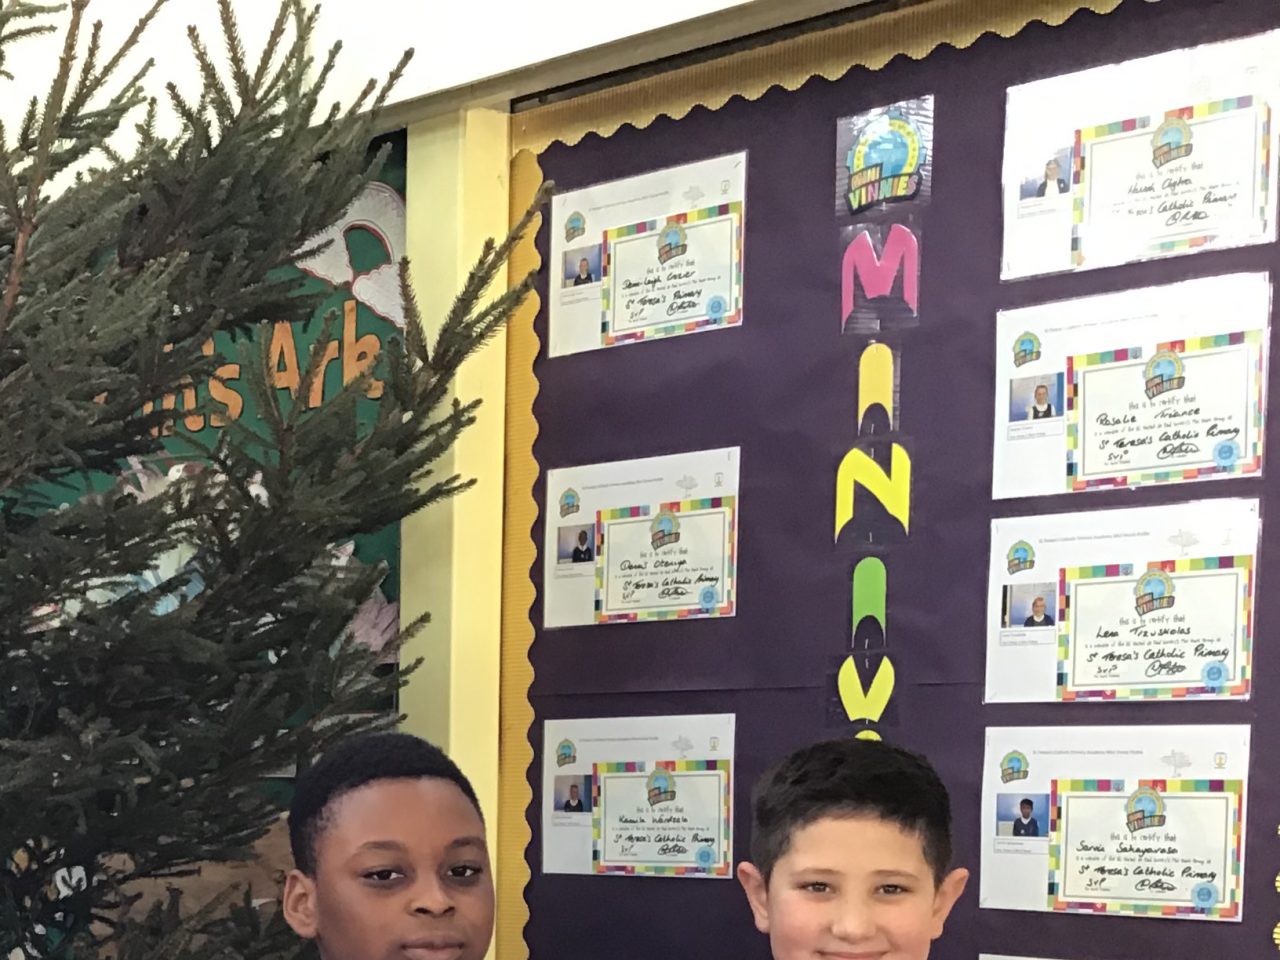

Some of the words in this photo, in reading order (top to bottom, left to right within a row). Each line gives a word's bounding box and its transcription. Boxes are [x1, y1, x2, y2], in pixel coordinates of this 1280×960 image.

[1157, 200, 1194, 213] Catholic
[1096, 412, 1137, 426] Rosalie
[1113, 435, 1153, 449] Teresa's
[1159, 430, 1200, 442] Catholic
[661, 576, 692, 587] Catholic
[1101, 650, 1139, 661] Teresa's
[1143, 647, 1186, 661] Catholic
[654, 834, 687, 843] Catholic
[1094, 866, 1128, 876] Teresa's
[1133, 866, 1175, 877] Catholic
